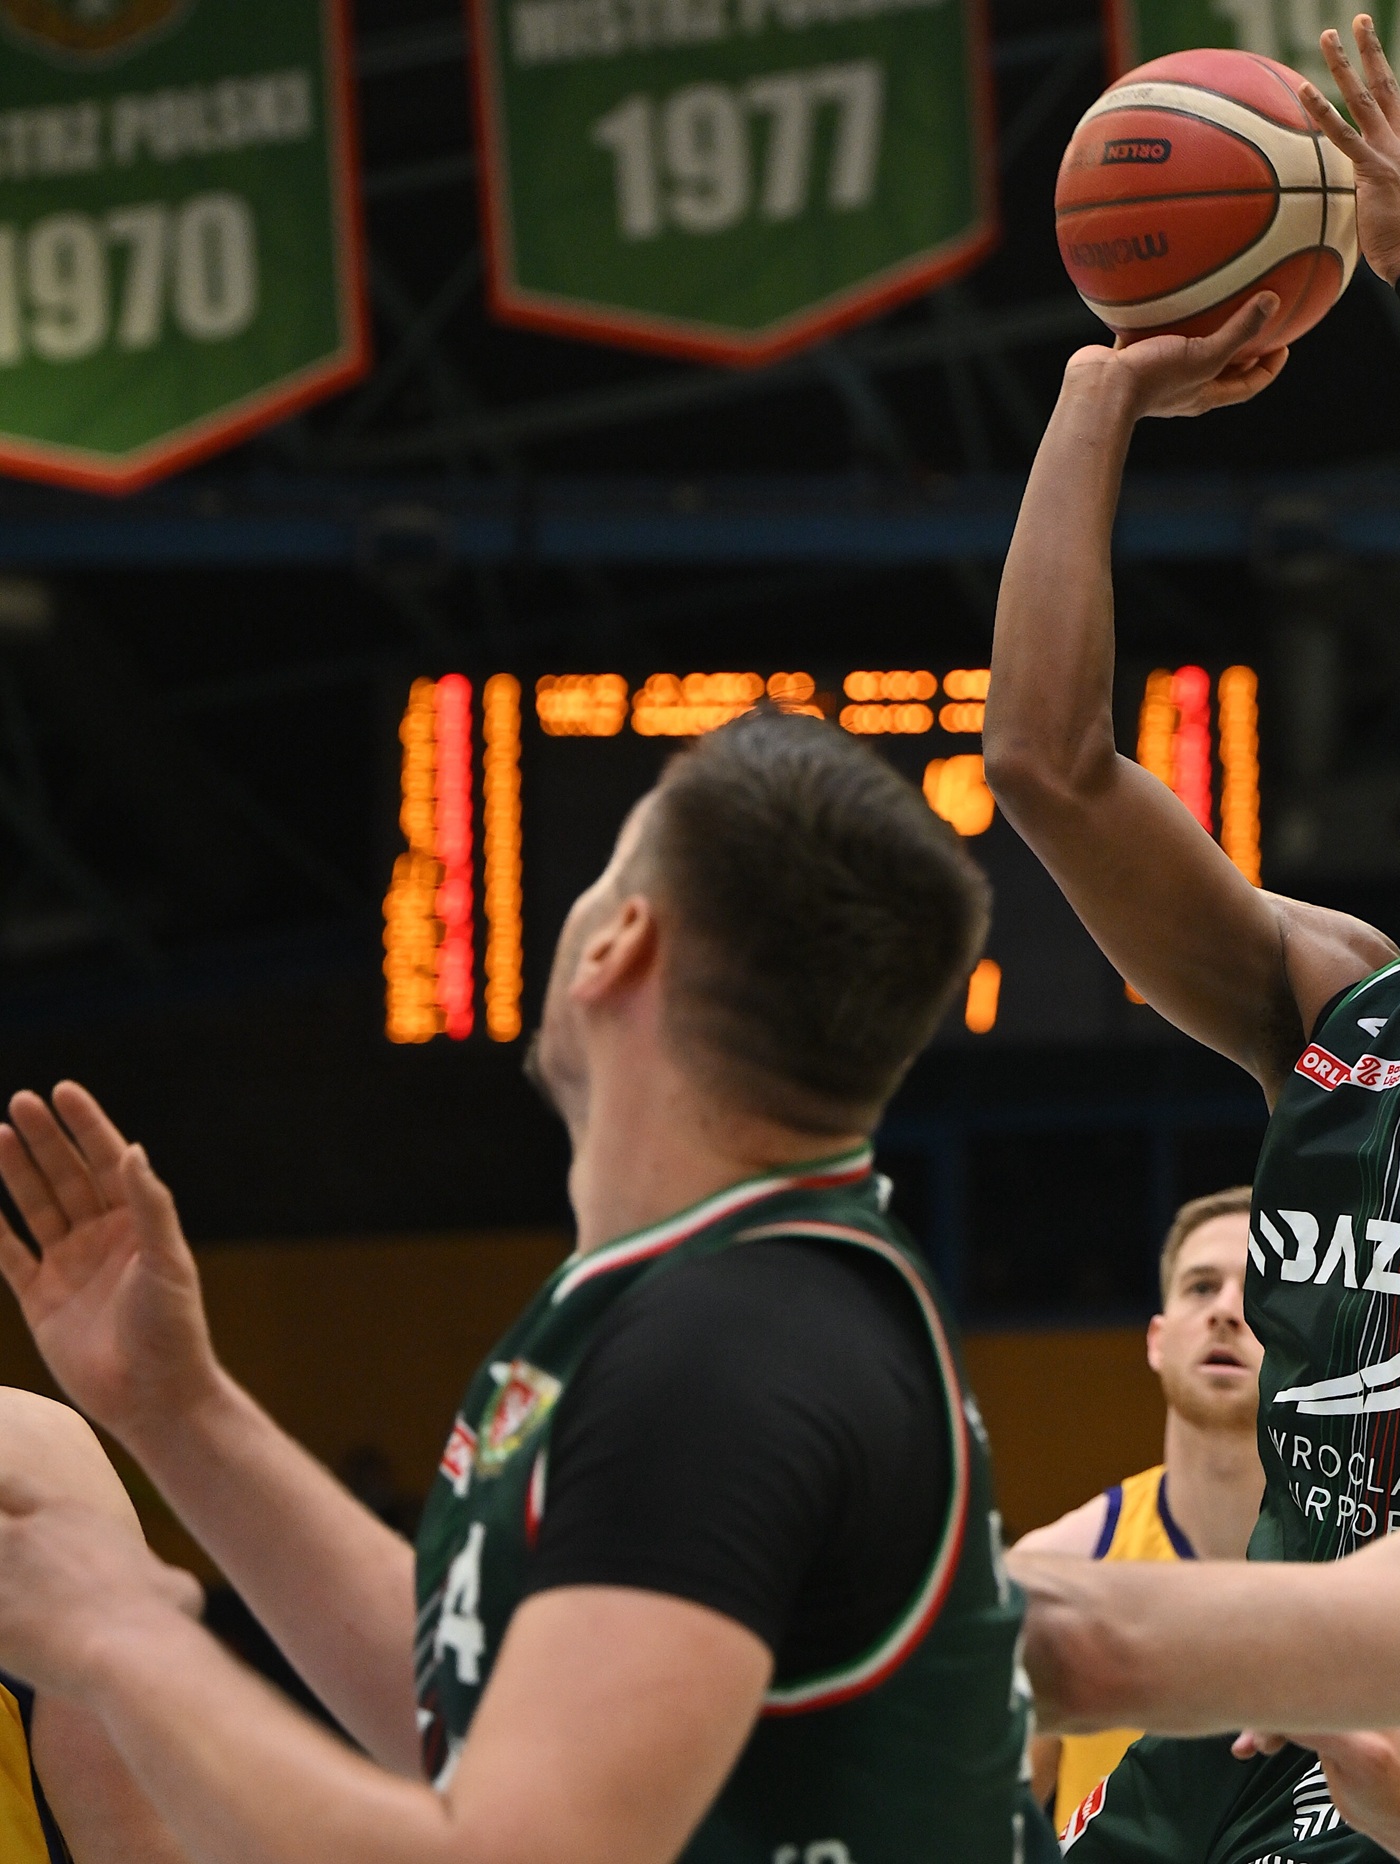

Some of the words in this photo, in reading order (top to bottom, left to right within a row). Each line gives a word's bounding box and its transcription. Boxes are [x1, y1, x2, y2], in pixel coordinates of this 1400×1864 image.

[592, 60, 886, 240] 1977
[1108, 143, 1164, 160] ORLEN
[1068, 232, 1169, 271] molten
[1302, 1052, 1349, 1084] ORL
[434, 1521, 486, 1684] 4
